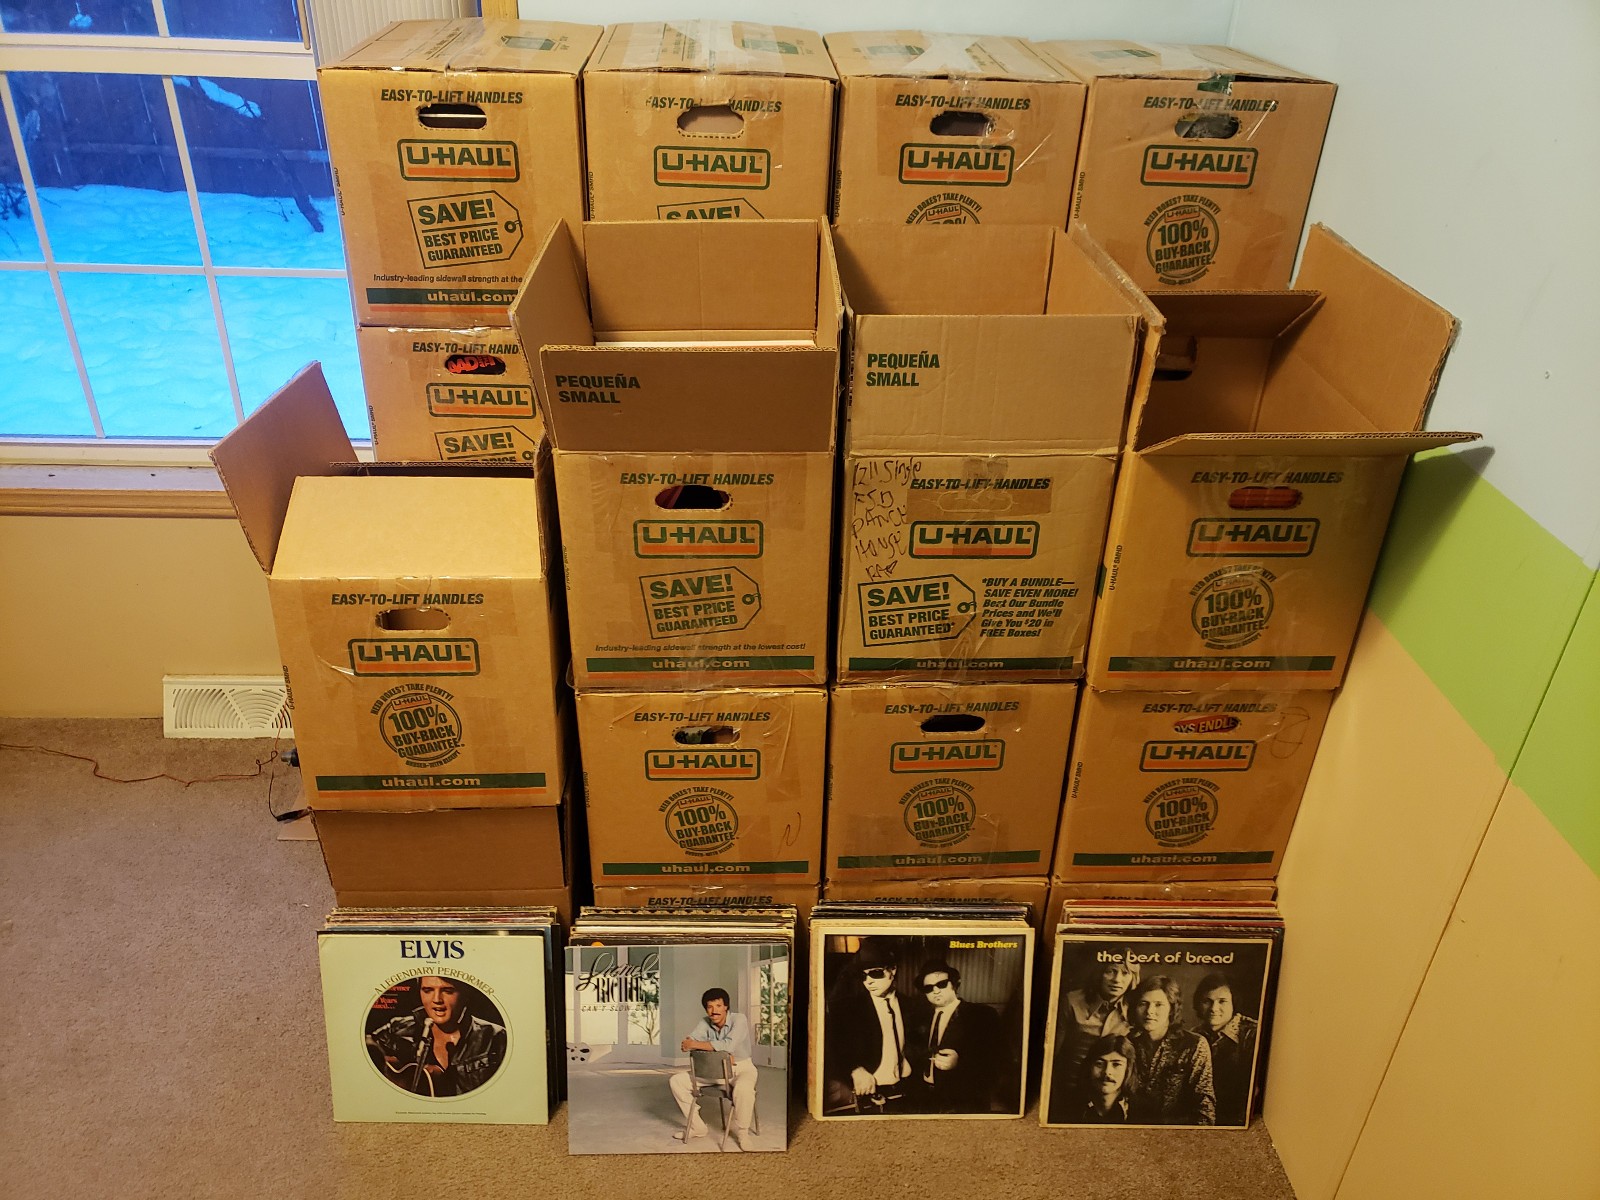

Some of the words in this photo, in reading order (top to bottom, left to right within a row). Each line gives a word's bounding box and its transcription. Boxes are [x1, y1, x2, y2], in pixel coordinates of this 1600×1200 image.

[380, 89, 463, 103] EASY-TO-LIFT
[466, 91, 523, 104] HANDLES
[417, 199, 496, 225] SAVE!
[423, 233, 456, 248] BEST
[461, 228, 499, 244] PRICE
[1158, 218, 1208, 246] 100%
[427, 243, 503, 262] GUARANTEED
[1155, 240, 1211, 261] BUY-BACK
[373, 274, 434, 283] Industry-leading
[468, 275, 499, 283] strength
[510, 275, 523, 283] the
[413, 342, 486, 354] EASY-TO-LIFT
[489, 344, 519, 355] HAND
[867, 351, 940, 369] PEQUEÑA
[555, 373, 641, 389] PEQUEÑA
[866, 372, 920, 387] SMALL
[559, 391, 621, 403] SMALL
[443, 431, 515, 453] SAVE!
[620, 473, 710, 485] EASY-TO-LIFT
[713, 473, 774, 485] HANDLES
[910, 478, 992, 489] EASY-TO-LIFT
[993, 478, 1050, 489] HANDLES
[1285, 472, 1344, 484] HANDLES
[650, 573, 733, 599] SAVE!
[1009, 578, 1018, 586] A
[331, 593, 420, 605] EASY-TO-LIFT
[423, 593, 484, 605] HANDLES
[868, 582, 950, 607] SAVE!
[984, 588, 1012, 598] SAVE
[1013, 588, 1043, 598] EVEN
[1043, 588, 1079, 597] MORE!
[1204, 586, 1262, 613] 100%
[653, 606, 689, 620] BEST
[694, 601, 735, 615] PRICE
[1008, 599, 1027, 608] Our
[1028, 599, 1064, 608] Bundle
[869, 614, 902, 627] BEST
[908, 610, 949, 623] PRICE
[982, 609, 1014, 618] Prices
[1016, 609, 1036, 618] and
[1038, 609, 1063, 618] We'll
[1201, 607, 1264, 628] BUY-BACK
[657, 614, 738, 633] GUARANTEED
[981, 619, 1003, 628] Give
[1006, 619, 1023, 628] You
[1024, 618, 1042, 628] $20
[1043, 619, 1054, 628] in
[980, 628, 1006, 638] FREE
[1007, 628, 1042, 638] Boxes!
[1173, 658, 1270, 669] uhaul.com
[884, 703, 963, 715] EASY-TO-LIFT
[966, 701, 1019, 712] HANDLES
[1142, 703, 1222, 713] EASY-TO-LIFT
[388, 704, 447, 732] 100%
[634, 711, 713, 722] EASY-TO-LIFT
[716, 711, 771, 722] HANDLES
[392, 724, 456, 747] BUY-BACK
[381, 776, 481, 788] uhaul.com
[913, 795, 964, 818] 100%
[1156, 795, 1208, 818] 100%
[674, 804, 726, 827] 100%
[914, 812, 969, 831] BUY-BACK
[1154, 812, 1210, 830] BUY-BACK
[676, 821, 732, 839] BUY-BACK
[895, 854, 982, 865] uhaul.com
[1131, 854, 1217, 864] uhaul.com
[661, 863, 750, 873] uhaul.com
[400, 940, 465, 959] ELVIS
[949, 940, 975, 949] Blues
[976, 940, 1018, 949] Brothers
[1097, 951, 1123, 963] the
[1127, 950, 1160, 963] best
[1164, 951, 1181, 963] of
[1186, 952, 1234, 964] bread
[380, 966, 435, 991] LEGENDARY
[438, 967, 495, 996] PERFORMER
